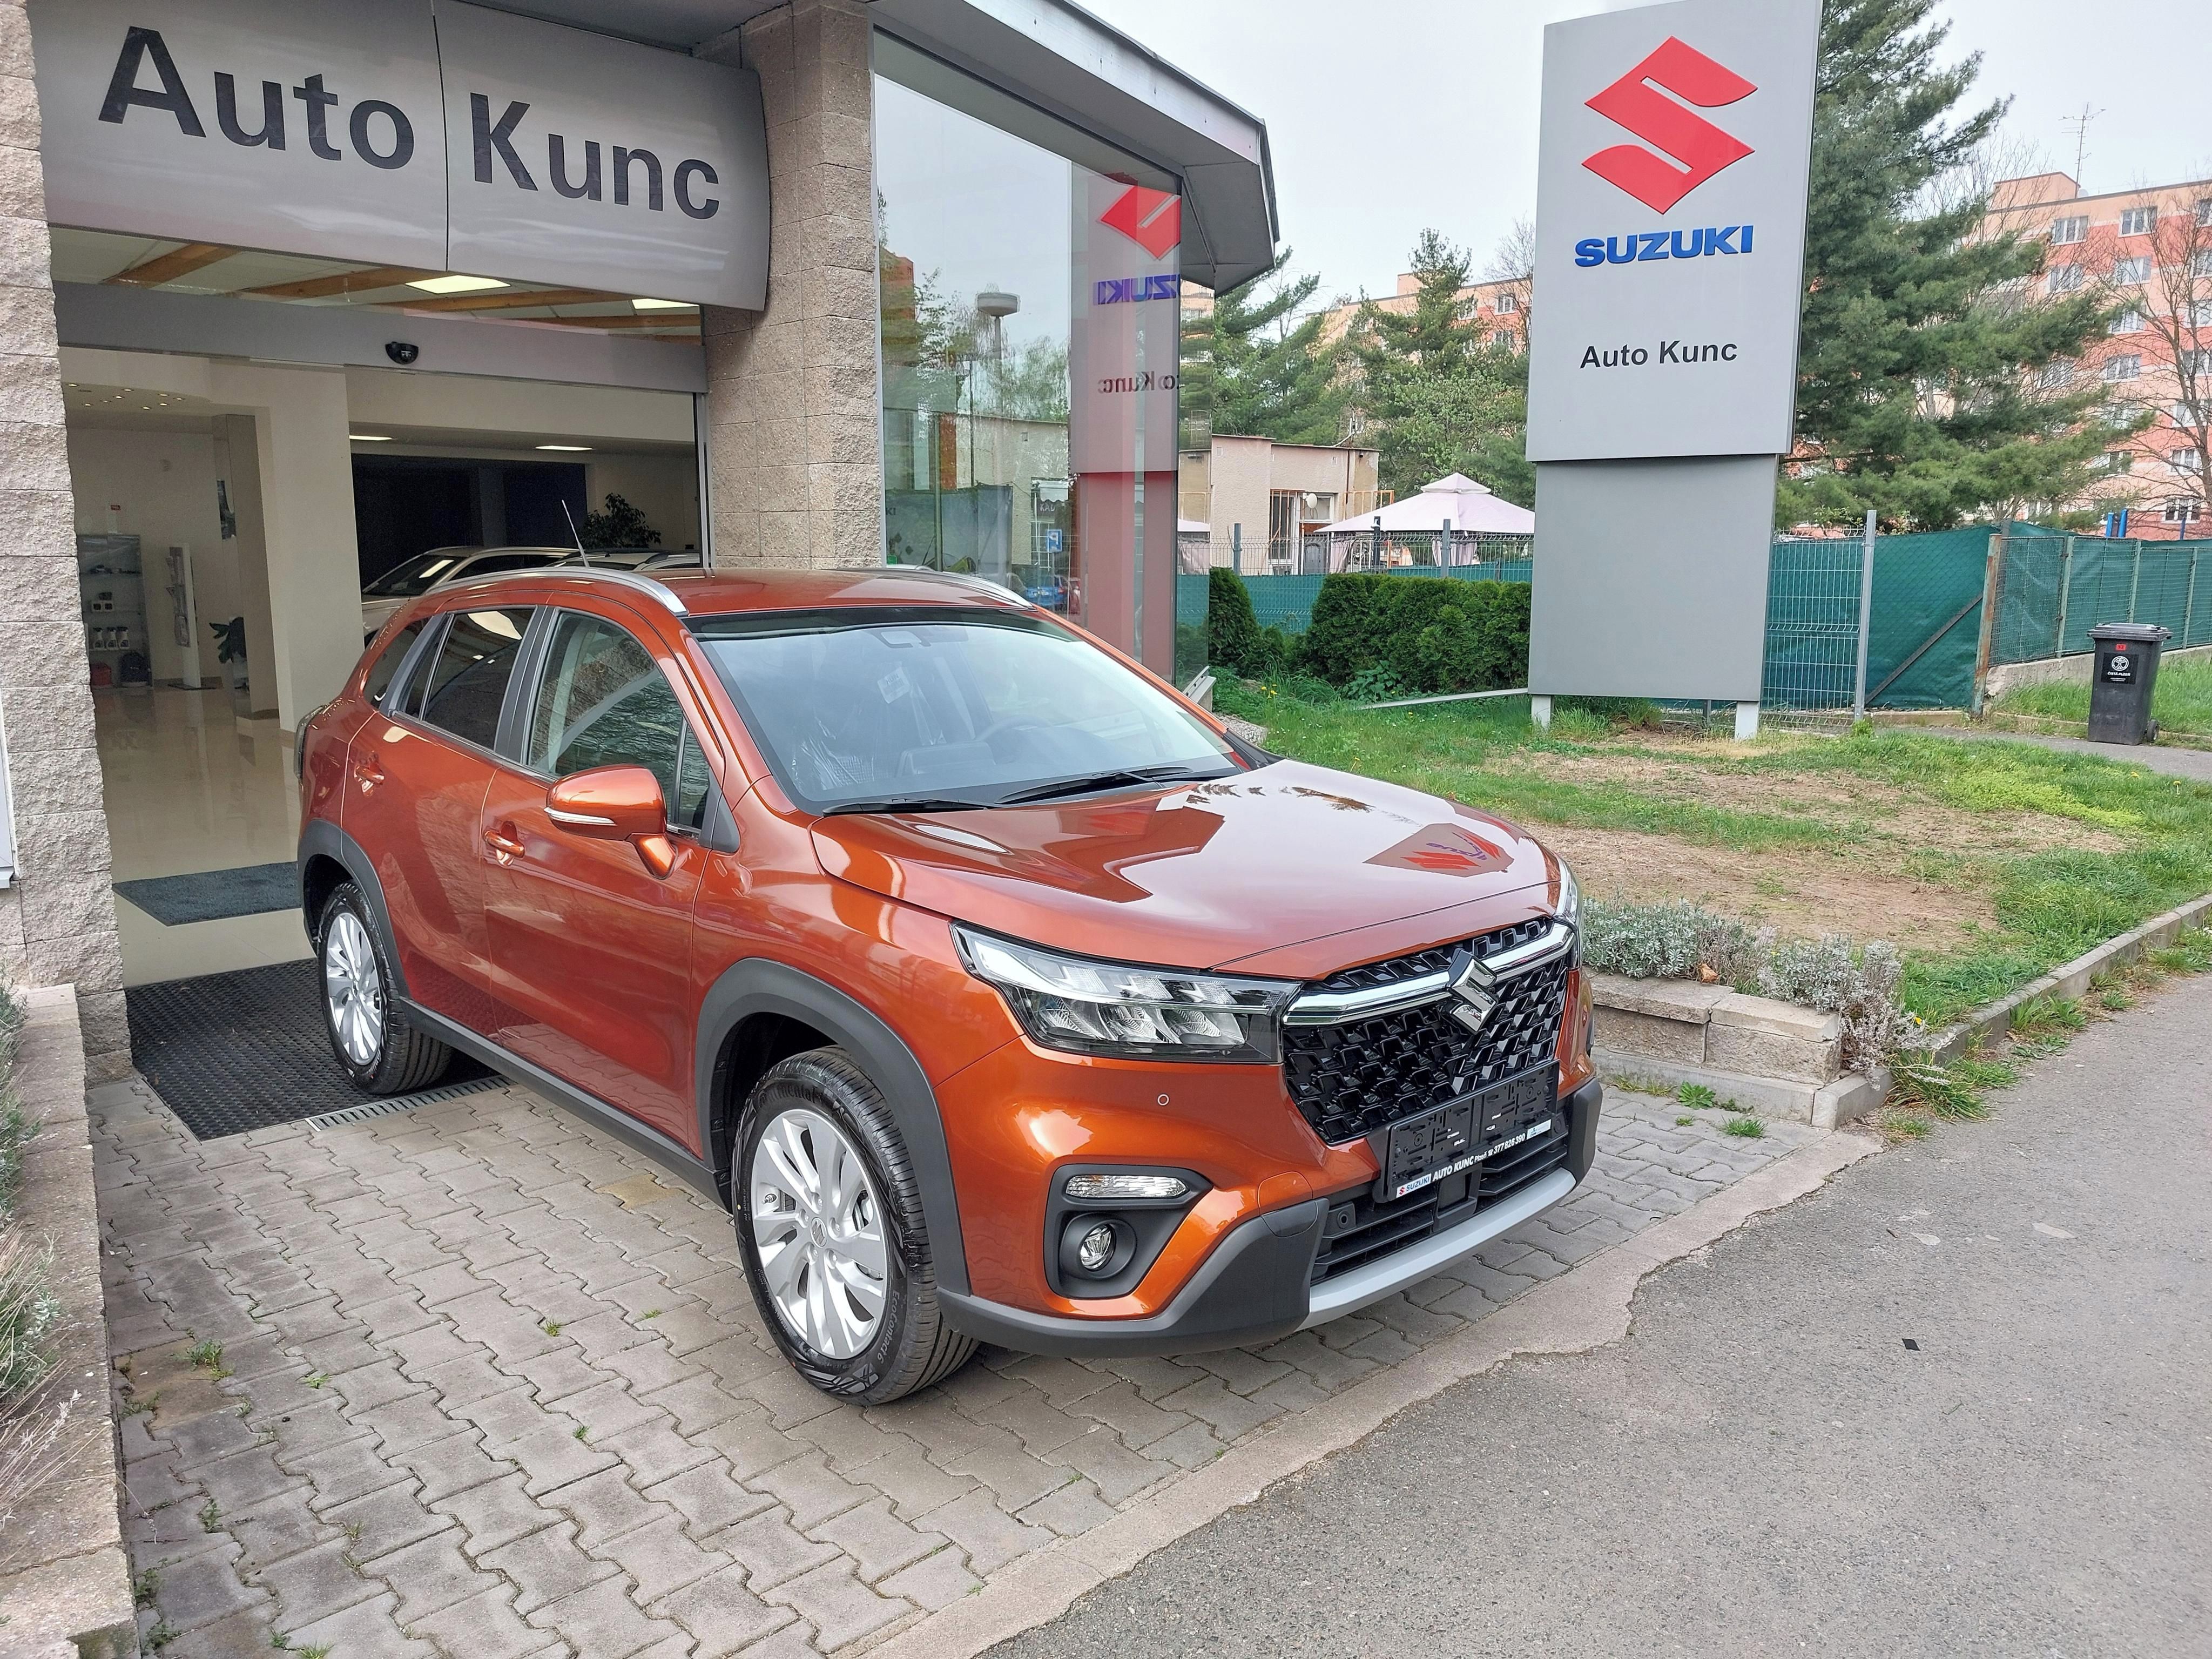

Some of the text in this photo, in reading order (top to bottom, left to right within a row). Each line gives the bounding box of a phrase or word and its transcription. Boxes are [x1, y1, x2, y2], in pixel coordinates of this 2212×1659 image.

[98, 26, 721, 220] Auto Kunc
[1574, 225, 1754, 267] SUZUKI
[1580, 340, 1738, 369] Auto Kunc
[1406, 1176, 1430, 1192] SUZUKI
[1432, 1165, 1453, 1182] AUTO
[1453, 1155, 1474, 1172] KUNC
[1494, 1142, 1505, 1155] 377
[1504, 1138, 1515, 1149] 826
[1515, 1132, 1526, 1144] 390
[877, 1352, 884, 1364] 6
